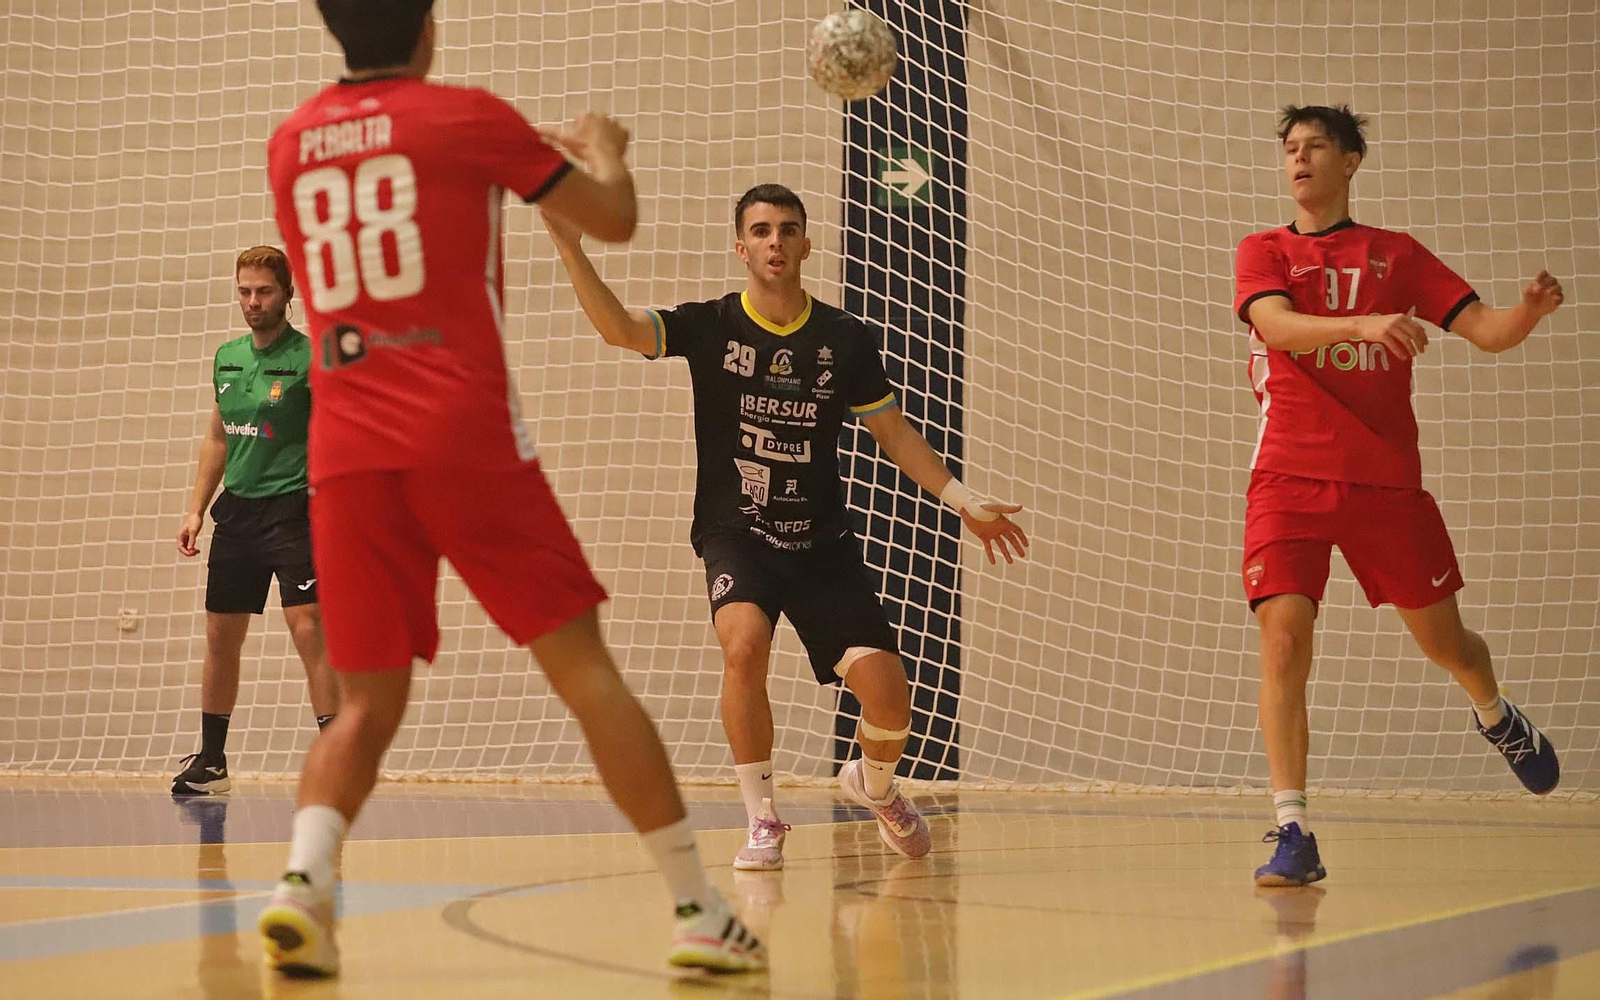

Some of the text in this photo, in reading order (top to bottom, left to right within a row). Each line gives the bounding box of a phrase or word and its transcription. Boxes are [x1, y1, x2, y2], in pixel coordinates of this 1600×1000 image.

[299, 113, 392, 165] PERALTA
[292, 153, 426, 313] 88
[1325, 267, 1361, 311] 97
[723, 340, 756, 378] 29
[740, 393, 818, 419] IBERSUR
[767, 440, 802, 453] DYPRE
